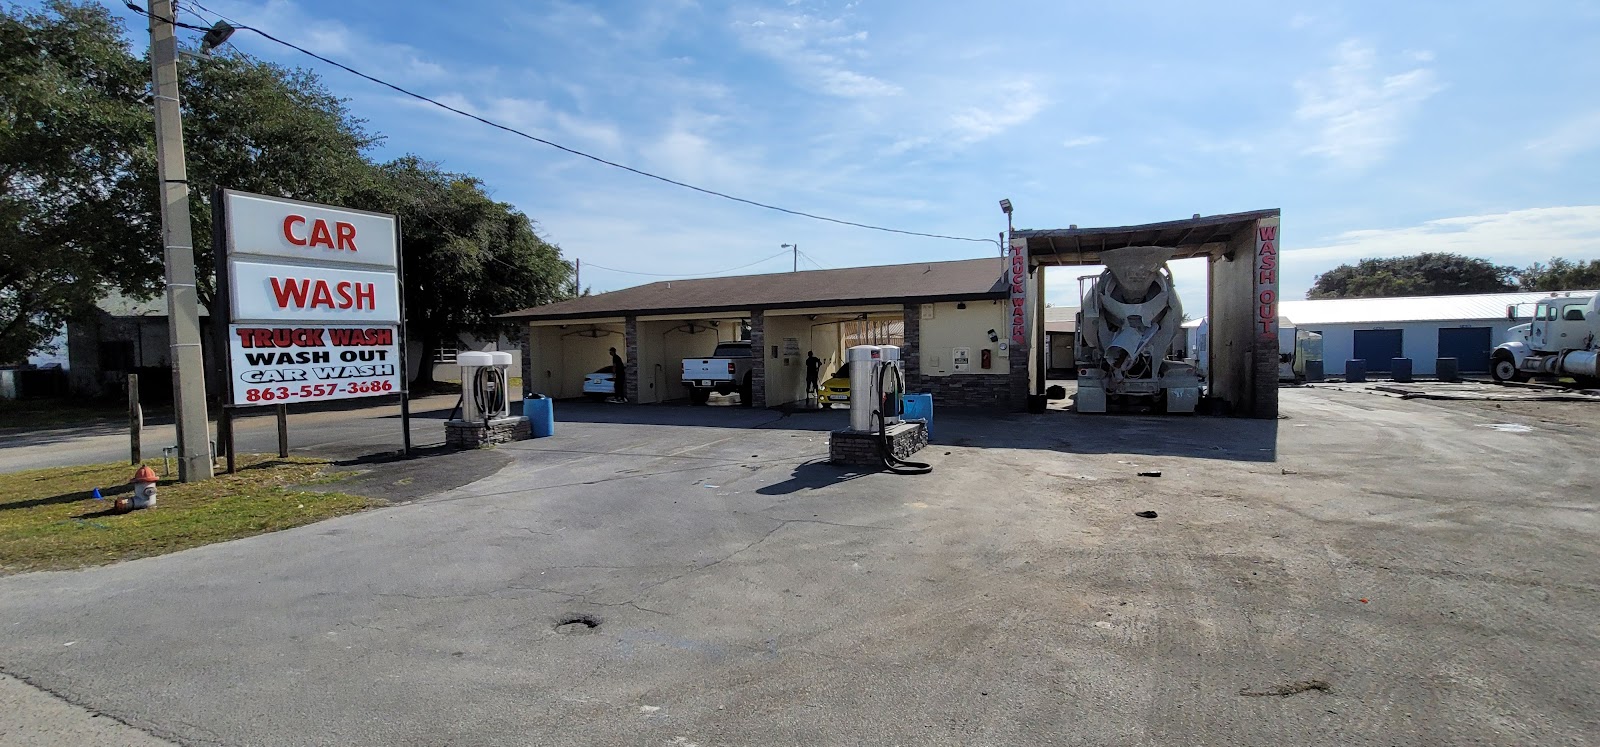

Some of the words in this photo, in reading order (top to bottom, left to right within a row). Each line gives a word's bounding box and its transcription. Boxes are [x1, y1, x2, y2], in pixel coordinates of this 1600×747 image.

[283, 214, 358, 252] CAR
[1012, 245, 1024, 294] TRUCK
[1258, 225, 1277, 285] WASH
[269, 276, 376, 311] WASH
[1258, 289, 1276, 334] OUT
[1012, 297, 1025, 336] WASH
[236, 328, 326, 349] TRUCK
[328, 328, 393, 346] WASH
[240, 368, 308, 384] CAR
[312, 364, 395, 380] WASH
[245, 350, 330, 366] WASH
[340, 349, 389, 363] OUT
[246, 380, 393, 402] 863-557-3686
